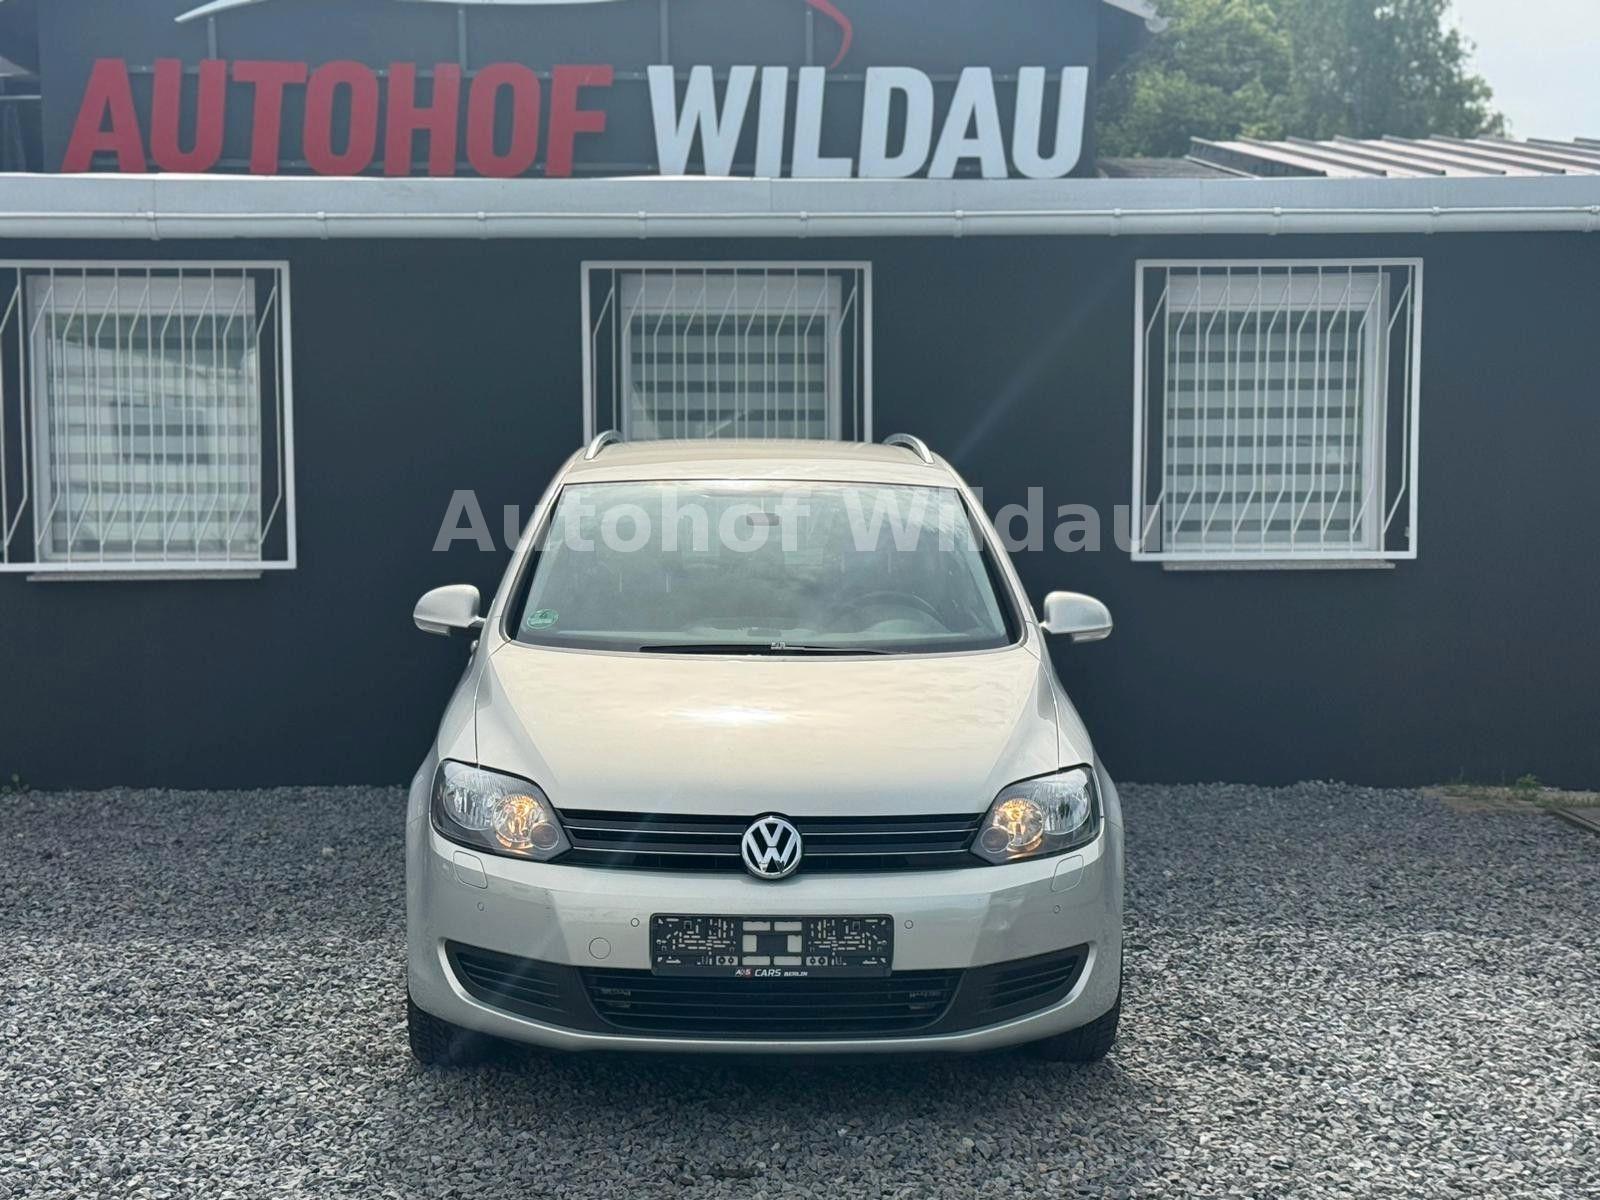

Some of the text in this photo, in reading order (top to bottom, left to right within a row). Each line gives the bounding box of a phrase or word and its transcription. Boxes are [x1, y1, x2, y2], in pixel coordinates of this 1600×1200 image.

[61, 58, 1089, 179] AUTOHOF WILDAU
[742, 816, 802, 878] VW
[754, 968, 781, 977] CARS
